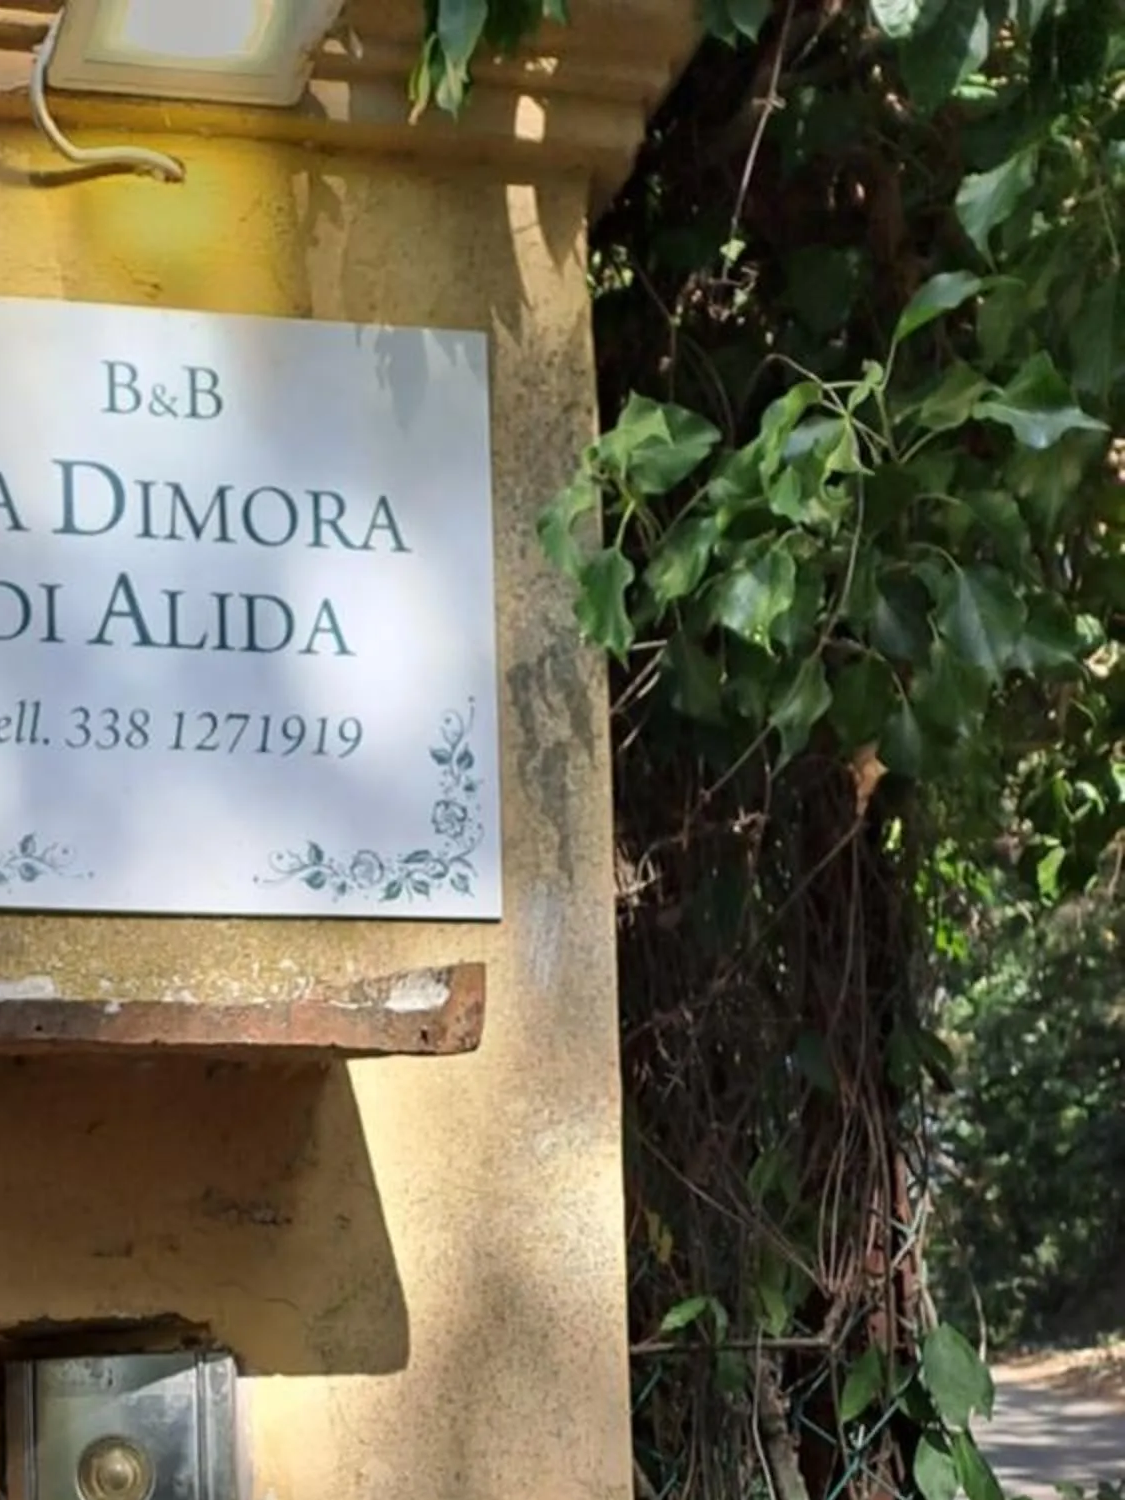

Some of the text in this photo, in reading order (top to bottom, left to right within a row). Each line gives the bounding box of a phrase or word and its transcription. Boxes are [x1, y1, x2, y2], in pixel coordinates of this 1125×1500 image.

[101, 359, 224, 421] B&B
[51, 458, 412, 553] DIMORA
[86, 572, 356, 657] ALIDA
[64, 707, 150, 749] 338
[169, 712, 364, 758] 1271919
